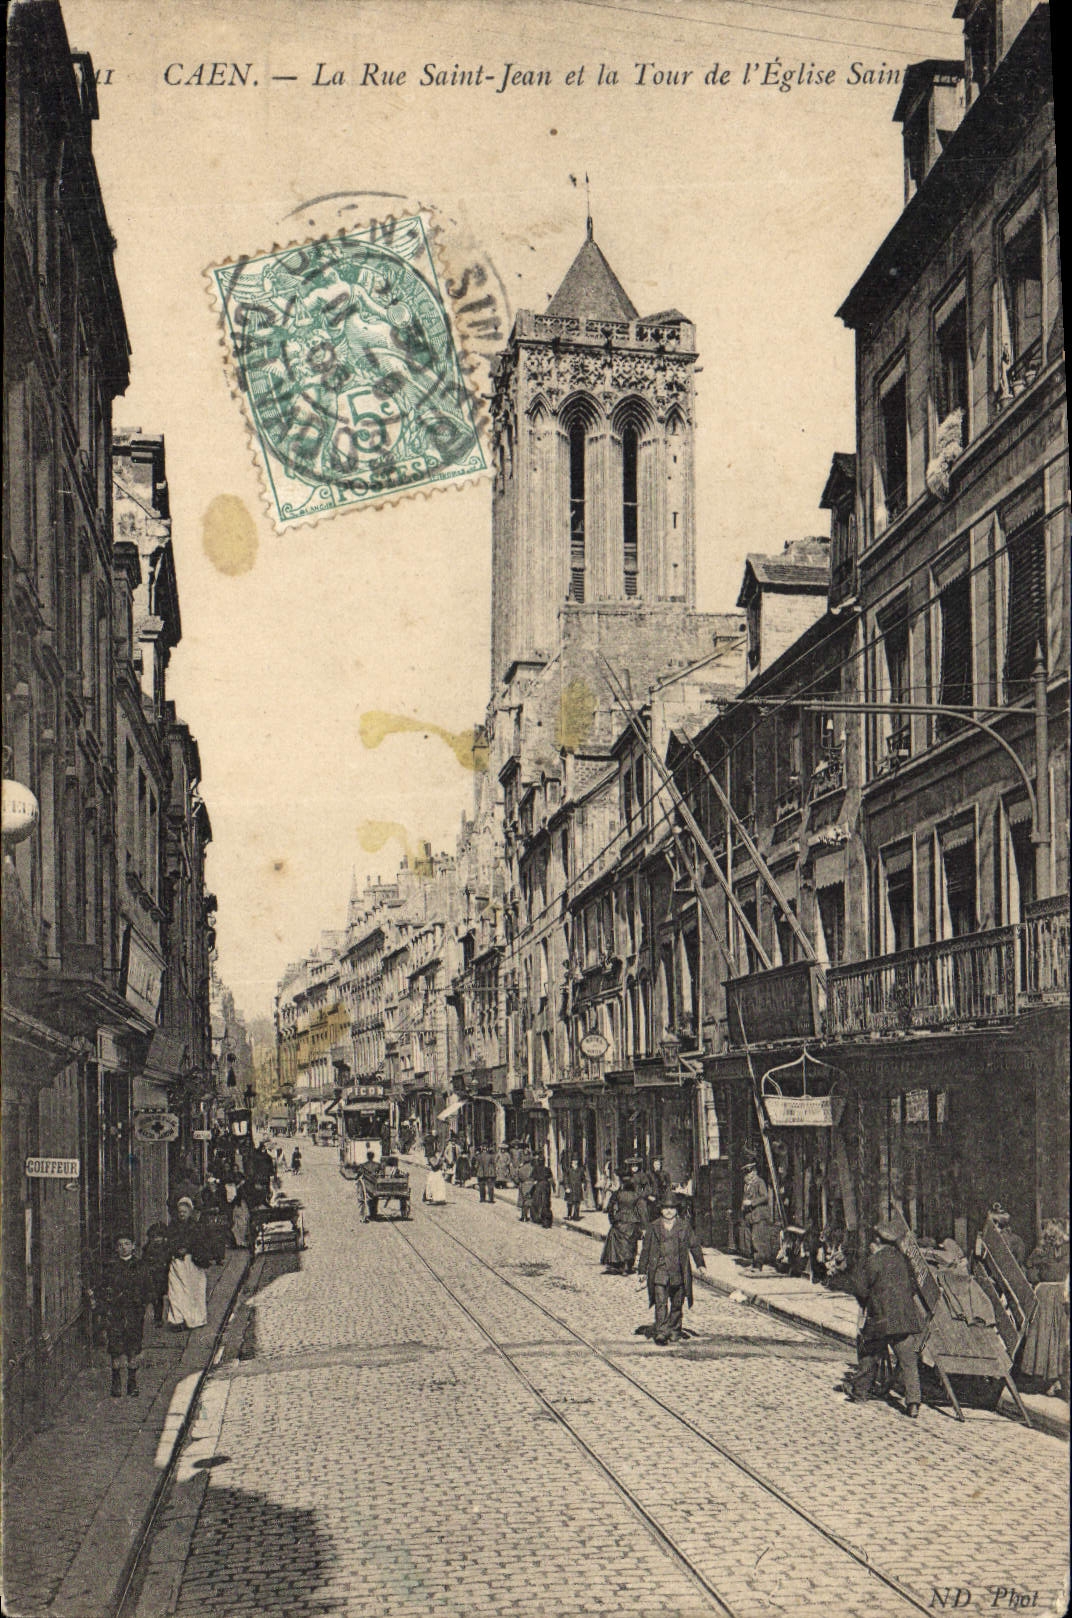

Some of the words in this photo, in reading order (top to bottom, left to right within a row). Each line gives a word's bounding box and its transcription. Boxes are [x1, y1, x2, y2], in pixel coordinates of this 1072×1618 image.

[336, 461, 426, 503] POSTES
[346, 1086, 384, 1097] PICON
[27, 1160, 78, 1176] COIFFEUR
